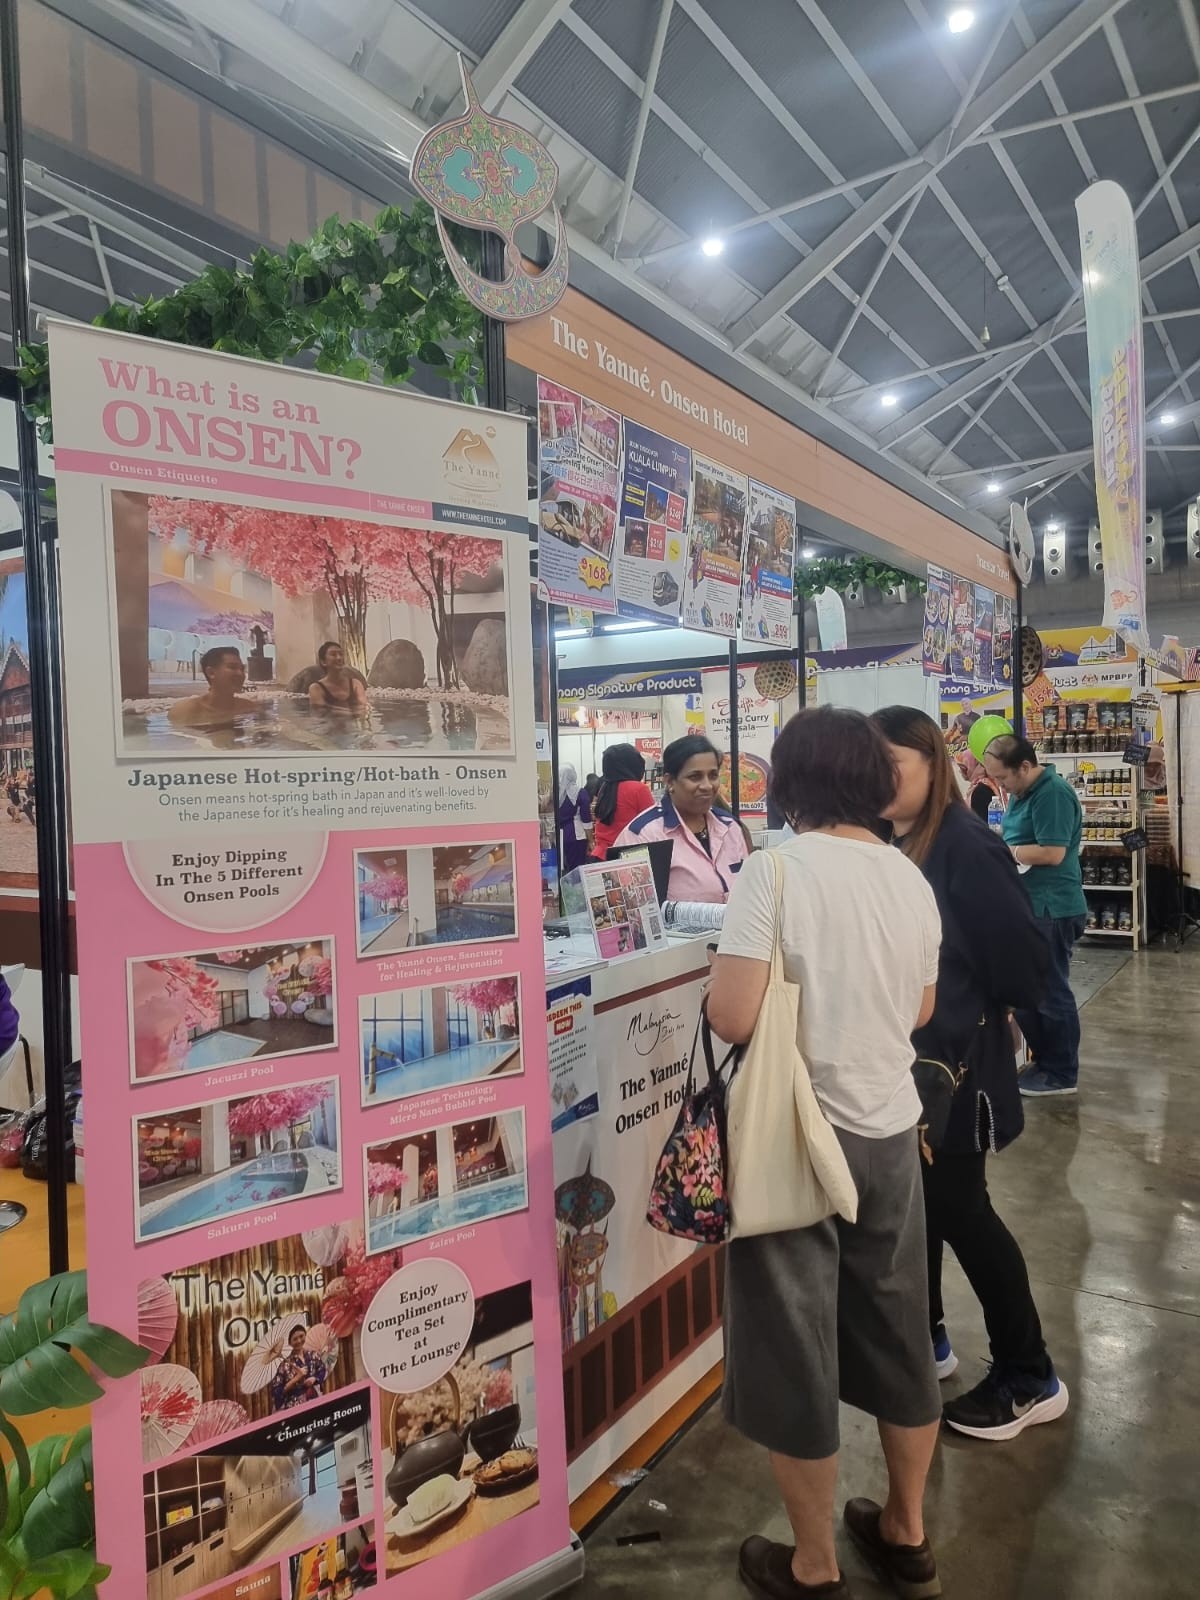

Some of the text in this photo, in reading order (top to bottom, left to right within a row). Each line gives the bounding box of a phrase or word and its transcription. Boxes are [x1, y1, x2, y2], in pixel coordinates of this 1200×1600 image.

[98, 357, 320, 424] What is an
[550, 315, 750, 446] The Yanné, Onsen Hotel
[102, 399, 362, 480] ONSEN?
[109, 460, 219, 486] Onsen Etiquette
[443, 460, 464, 473] The
[629, 451, 651, 468] KUALA
[651, 460, 677, 479] LUMPUR
[588, 563, 606, 581] 168
[557, 675, 697, 700] nang Signature Product
[940, 685, 970, 696] enang
[712, 714, 769, 726] Penag Curry
[725, 724, 756, 733] Msala
[127, 769, 238, 790] Japanese
[244, 766, 440, 787] Hot-spring/Hot-bath
[455, 766, 508, 779] Onsen
[159, 793, 201, 806] Onsen
[249, 791, 309, 806] hot-spring
[312, 789, 338, 801] bath
[341, 789, 351, 800] in
[354, 791, 385, 802] Japan
[387, 787, 406, 799] and
[408, 787, 422, 798] it's
[425, 785, 475, 798] well-loved
[477, 786, 490, 798] by
[178, 799, 478, 823] the Japanese for it's healing and rejuvenating benefits.
[172, 849, 288, 868] Enjoy Dipping
[156, 865, 304, 887] In The 5 Different
[184, 884, 281, 903] Onsen Pools
[377, 961, 395, 971] The
[459, 948, 503, 961] Sanctuary
[380, 972, 394, 982] for
[397, 966, 433, 979] Healing
[444, 958, 504, 974] Rejuvenation
[569, 1001, 582, 1012] THIS
[627, 1008, 681, 1056] Malaysia
[205, 1065, 275, 1087] Jacuzzi Pool
[619, 1052, 689, 1101] The Yanné
[390, 1095, 498, 1126] Micro Nano Bubble Pool
[398, 1085, 495, 1113] Japanese Technology
[615, 1102, 660, 1134] Onsen
[663, 1078, 698, 1110] Hotl
[207, 1211, 278, 1239] Sakura Pool
[456, 1228, 476, 1241] Pool
[172, 1267, 326, 1308] The Yanné
[400, 1284, 439, 1304] Enjoy
[368, 1291, 469, 1333] Complimentary
[224, 1309, 312, 1348] Onn
[395, 1316, 445, 1341] Tea Set
[414, 1336, 428, 1350] at
[380, 1340, 461, 1378] The Lounge
[277, 1403, 362, 1443] Changing Room
[235, 1575, 271, 1597] Sauna
